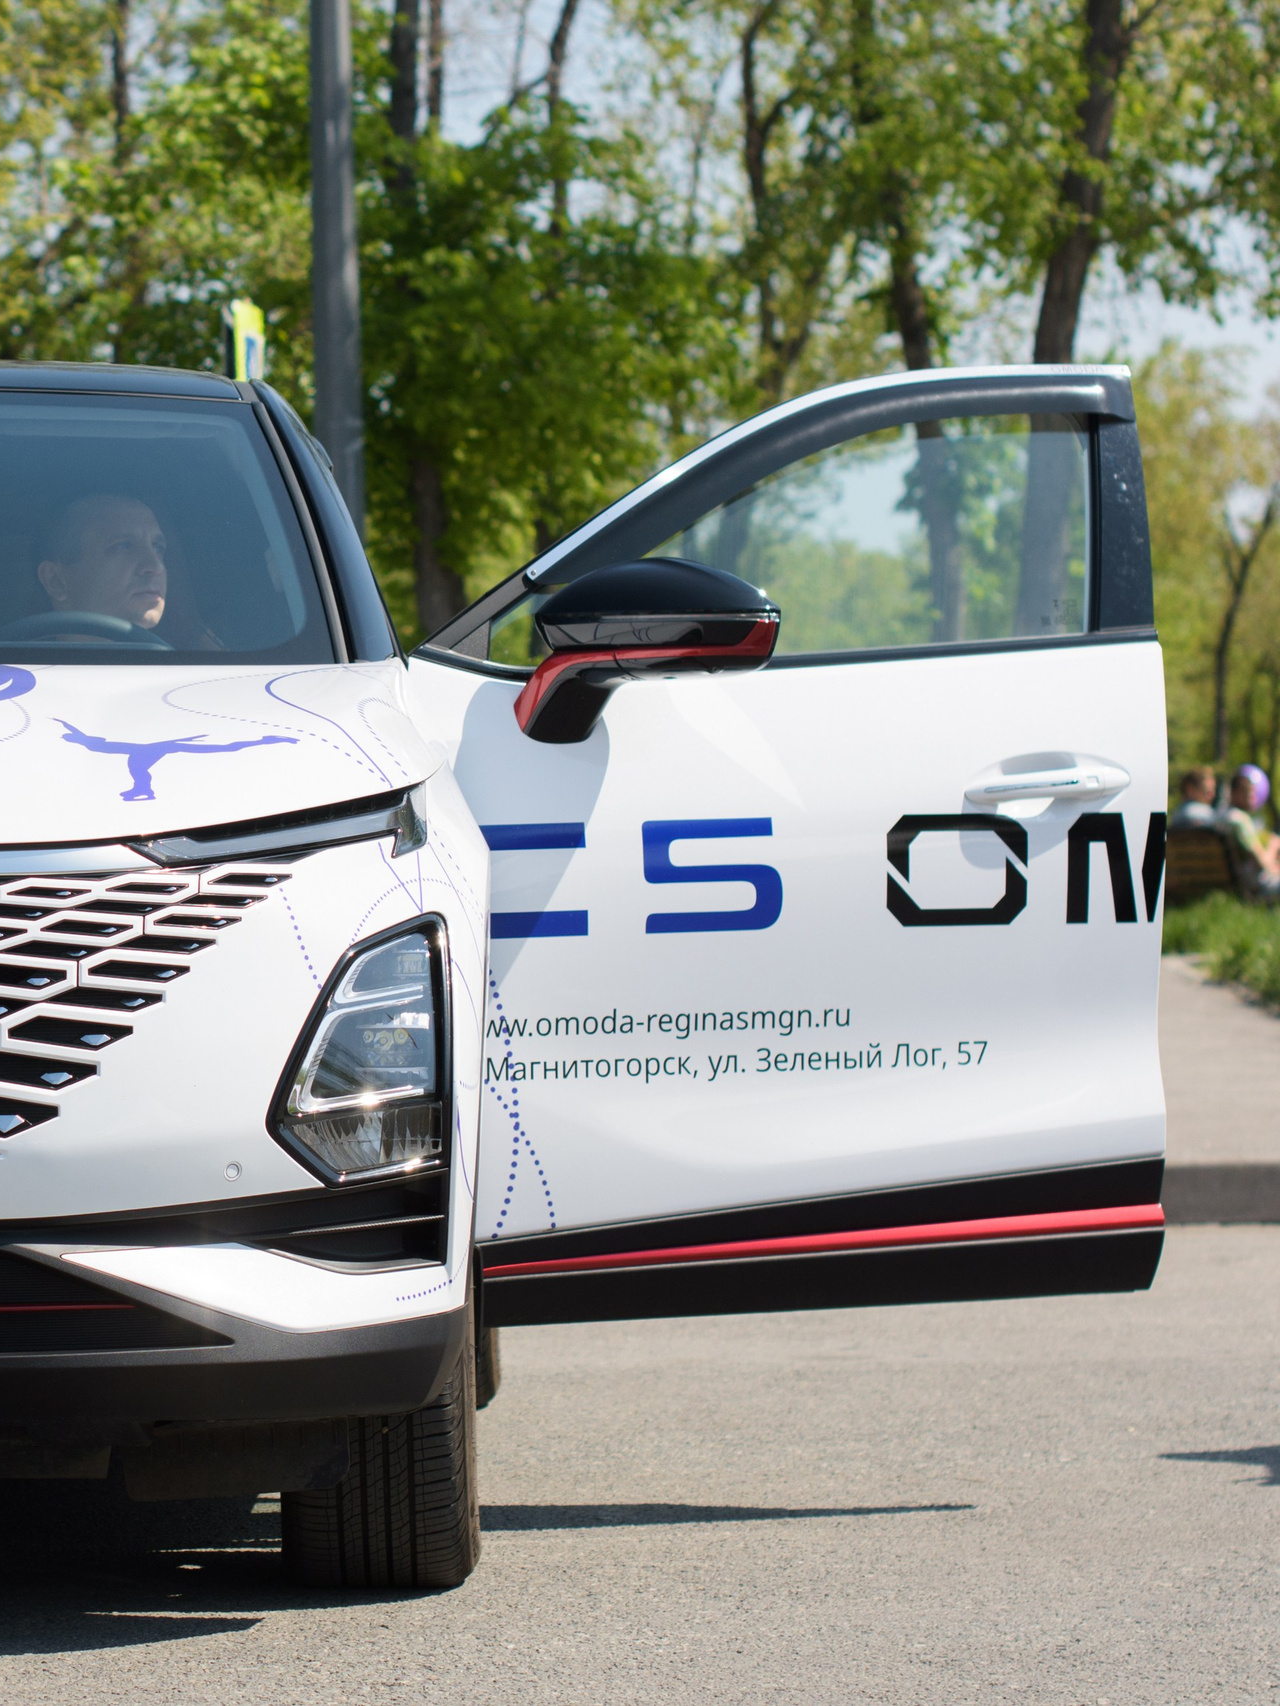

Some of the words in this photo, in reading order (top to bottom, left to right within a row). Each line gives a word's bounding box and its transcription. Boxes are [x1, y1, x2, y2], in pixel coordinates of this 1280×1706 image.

[486, 1054, 699, 1084] Магнитогорск,
[707, 1053, 746, 1082] ул.
[755, 1042, 883, 1073] Зеленый
[891, 1042, 947, 1070] Лог,
[957, 1040, 989, 1066] 57
